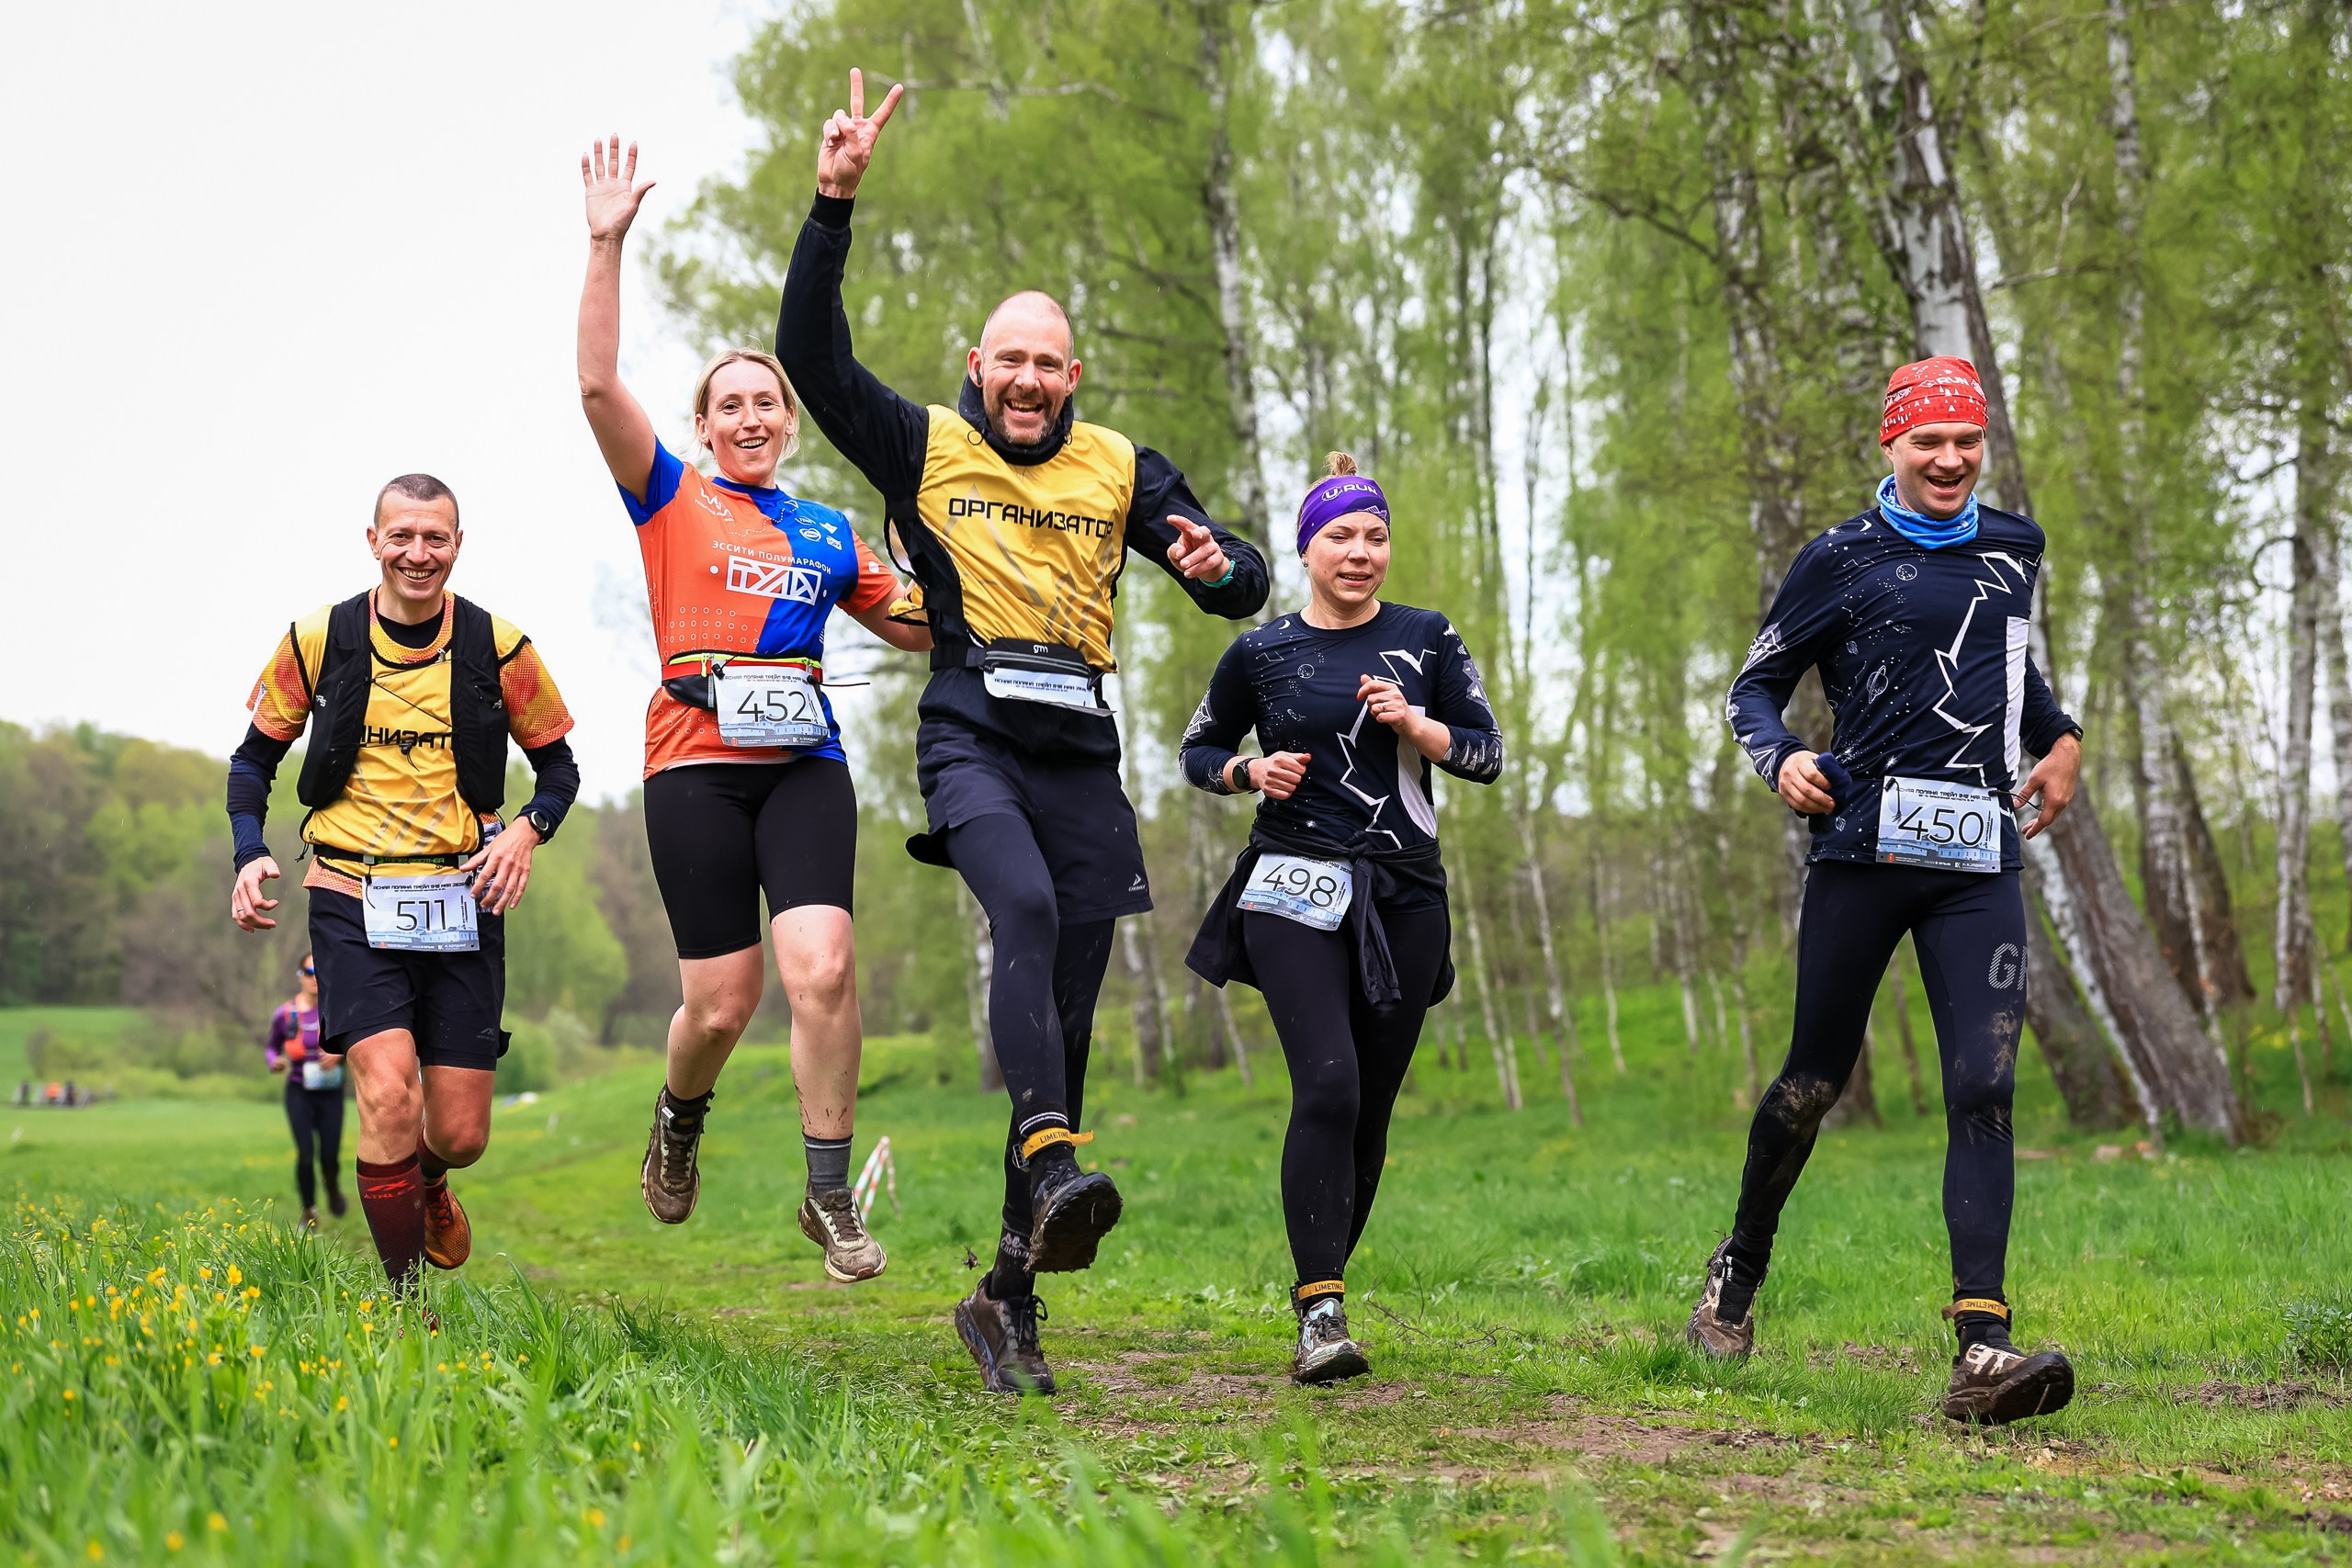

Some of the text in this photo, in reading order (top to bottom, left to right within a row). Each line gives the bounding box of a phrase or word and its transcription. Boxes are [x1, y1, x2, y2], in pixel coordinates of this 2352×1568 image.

[948, 497, 1114, 539] ОРГАНИЗАТОР
[712, 540, 831, 575] ЭССИТИ ПОЛУМАРАФОН
[737, 691, 812, 723] 452
[1898, 806, 1984, 847] 450
[1262, 863, 1338, 908] 498
[396, 899, 447, 931] 511
[1039, 1131, 1069, 1144] LIMETIME
[1315, 1282, 1343, 1292] LIMETIME
[1964, 1301, 2000, 1313] LIMETIME
